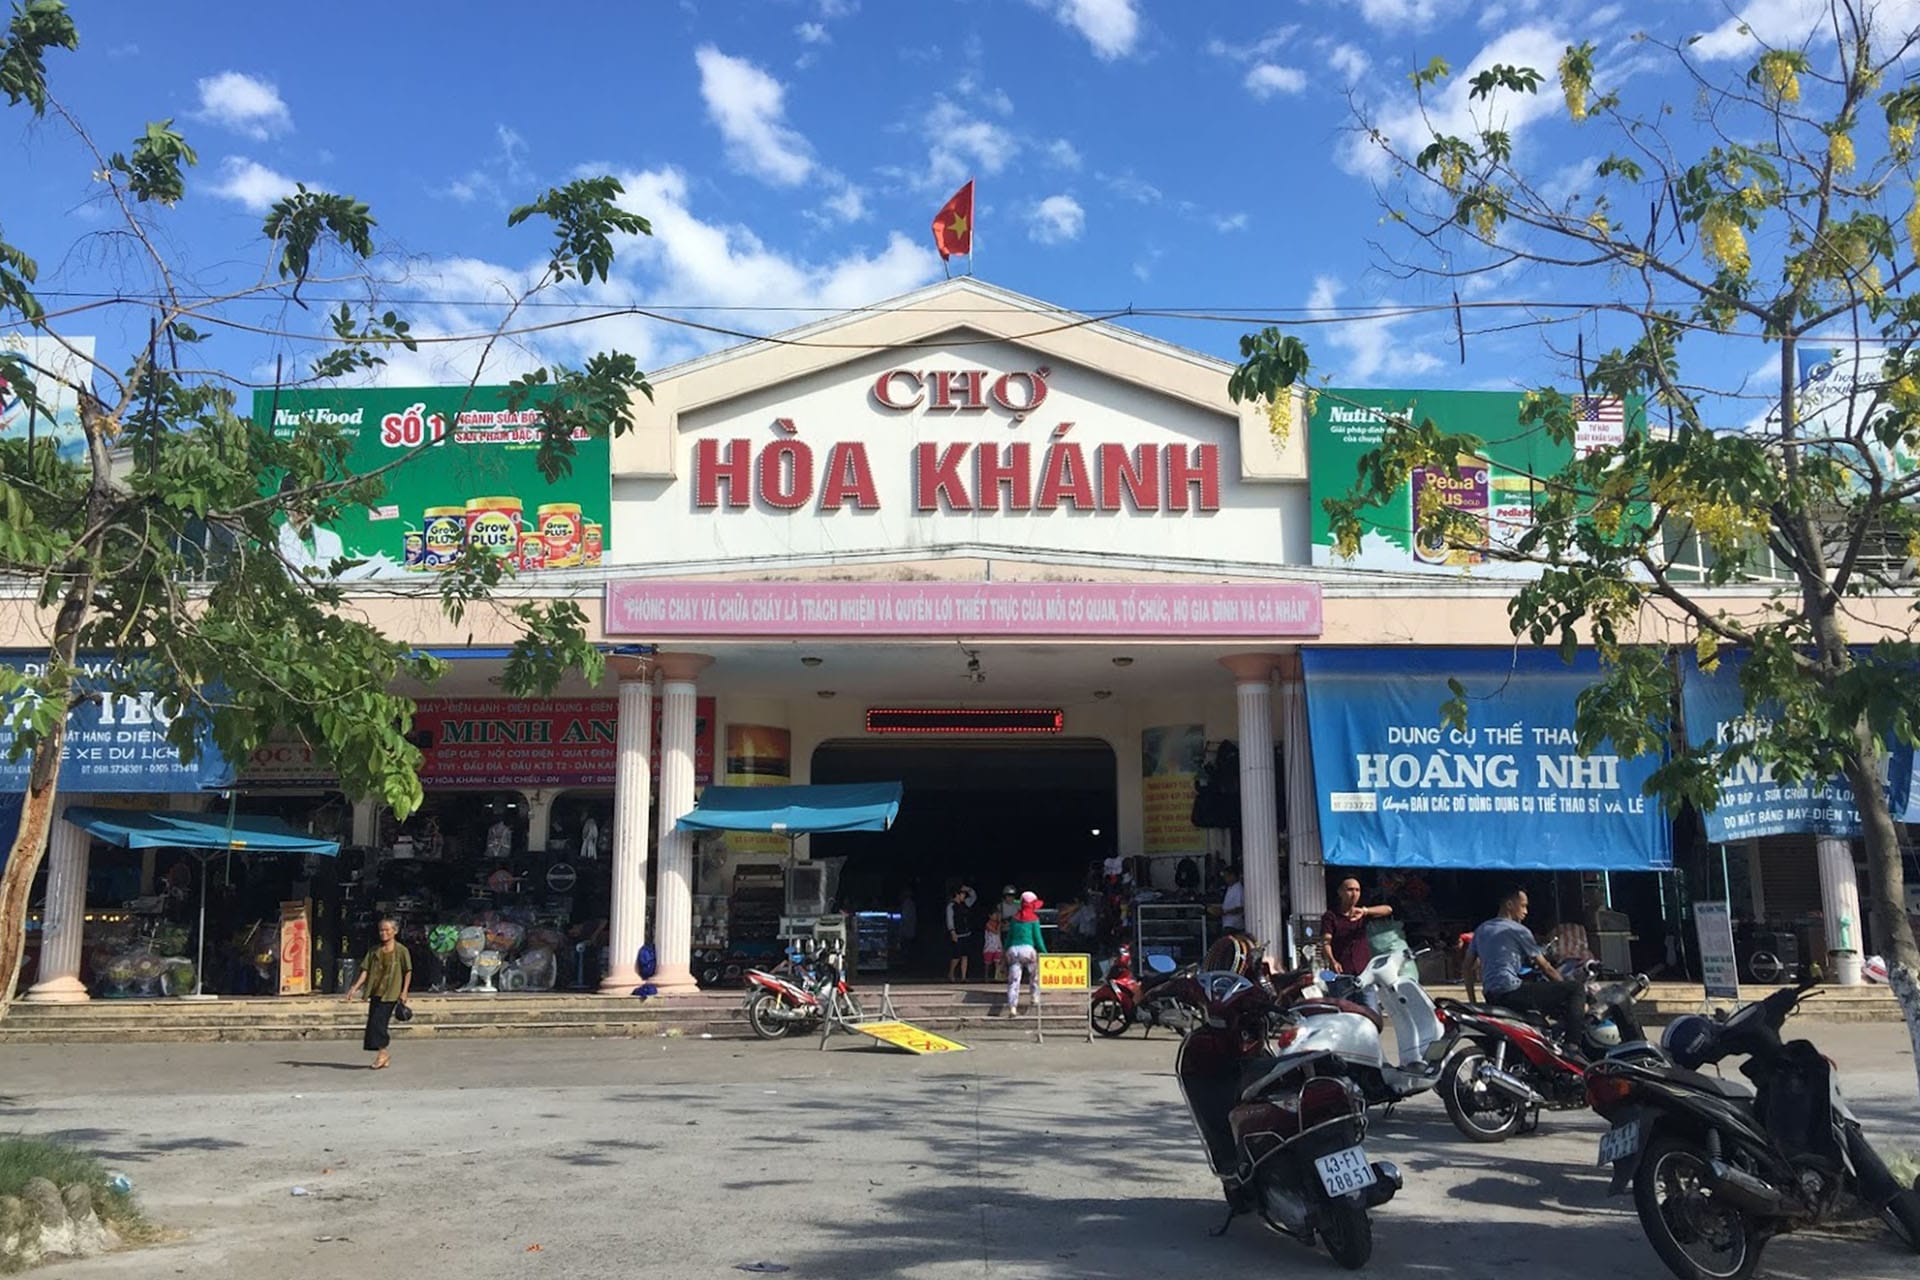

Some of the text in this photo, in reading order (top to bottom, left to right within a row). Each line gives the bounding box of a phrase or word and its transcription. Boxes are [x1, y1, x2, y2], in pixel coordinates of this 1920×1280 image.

[871, 365, 1051, 423] CHỢ
[381, 403, 426, 447] SỐ
[696, 417, 1221, 514] HÒA KHÁNH
[475, 522, 510, 533] Grow
[547, 522, 569, 530] Grow
[472, 534, 516, 546] PLUS+
[441, 719, 553, 745] MINH
[1388, 727, 1441, 747] DỤNG
[1450, 728, 1476, 749] CỤ
[1485, 721, 1523, 745] THẾ
[76, 747, 102, 760] XE
[109, 748, 134, 760] DU
[1356, 749, 1621, 789] HOÀNG NHI
[1560, 797, 1586, 812] THAO
[1324, 1150, 1360, 1175] 43-F1
